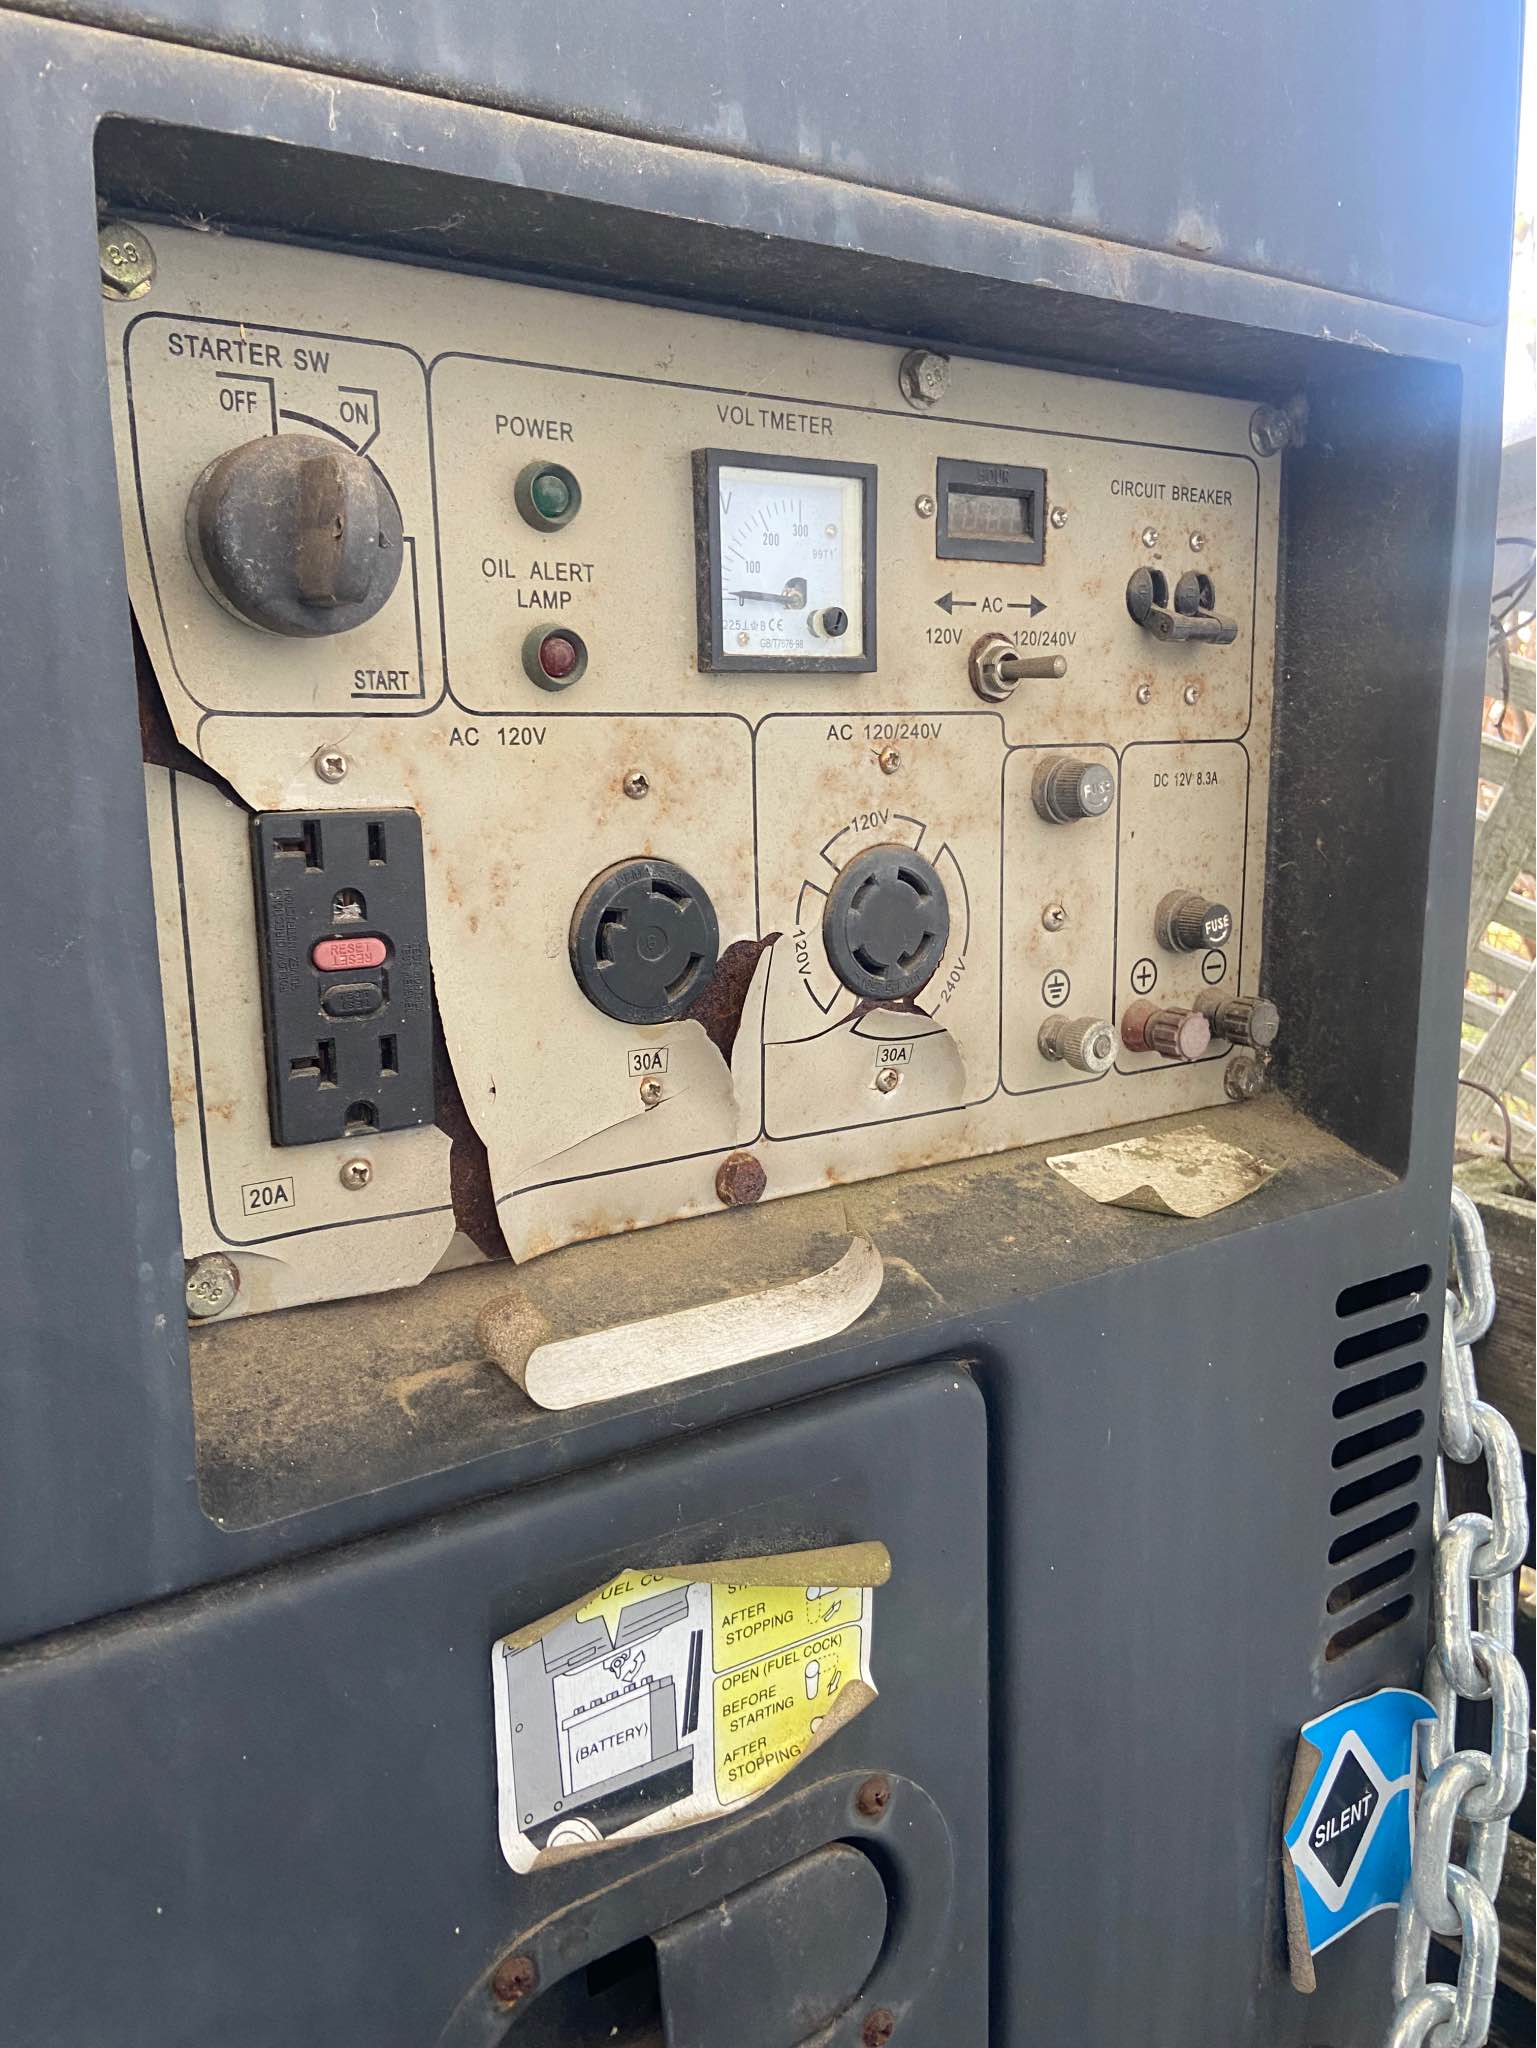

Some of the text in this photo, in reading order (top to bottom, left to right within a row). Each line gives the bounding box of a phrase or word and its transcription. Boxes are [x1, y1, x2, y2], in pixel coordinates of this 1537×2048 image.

[168, 333, 330, 373] STARTER SW
[219, 388, 257, 413] OFF
[339, 401, 369, 425] ON
[717, 405, 834, 436] VOLTMETER
[496, 414, 574, 442] POWER
[1111, 480, 1233, 506] CIRCUIT BREAKER
[763, 533, 780, 546] 200
[792, 524, 809, 537] 300
[481, 558, 595, 584] OIL ALERT
[745, 561, 761, 574] 100
[516, 590, 572, 610] LAMP
[981, 597, 1004, 613] AC
[926, 628, 963, 646] 120V
[1013, 630, 1077, 647] 120/240V
[353, 670, 409, 691] START
[449, 727, 547, 746] AC 120V
[827, 723, 942, 741] AC 120/240V
[1153, 772, 1218, 787] DC 12V 8.3A
[852, 809, 890, 832] 120V
[1205, 914, 1230, 934] FUSE
[330, 941, 371, 956] RESET
[793, 930, 811, 975] 120V
[940, 960, 967, 1004] 240V
[633, 1052, 663, 1072] 30A
[881, 1047, 906, 1063] 30A
[249, 1184, 289, 1208] 20A
[722, 1602, 766, 1628] AFTER
[726, 1611, 793, 1645] STOPPING
[722, 1634, 842, 1691] OPEN (FUEL COCK)
[723, 1685, 777, 1717] BEFORE
[730, 1696, 794, 1732] STARTING
[575, 1723, 649, 1763] (BATTERY)
[723, 1736, 767, 1765] AFTER
[728, 1744, 801, 1782] STOPPING
[1314, 1793, 1373, 1849] SILENT
